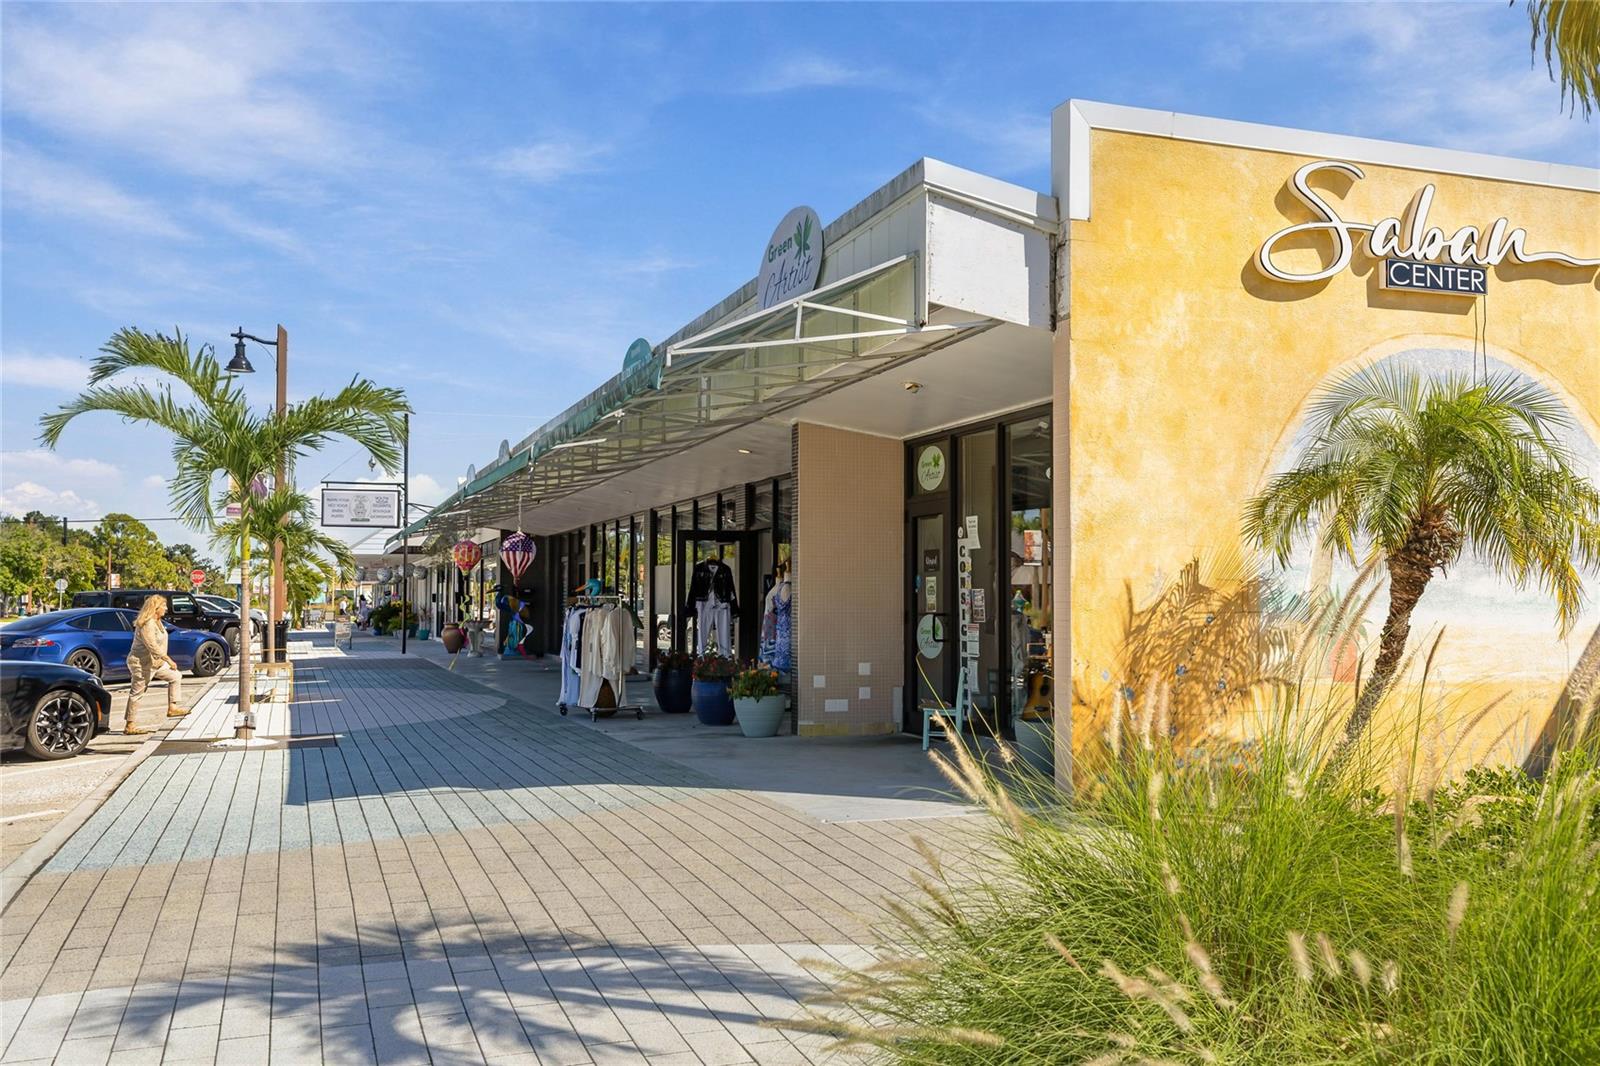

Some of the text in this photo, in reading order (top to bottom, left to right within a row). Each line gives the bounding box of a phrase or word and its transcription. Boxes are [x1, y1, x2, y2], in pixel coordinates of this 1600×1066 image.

[1255, 160, 1600, 283] Saban
[767, 236, 793, 263] Green
[763, 255, 813, 309] Artist
[1389, 260, 1485, 293] CENTER
